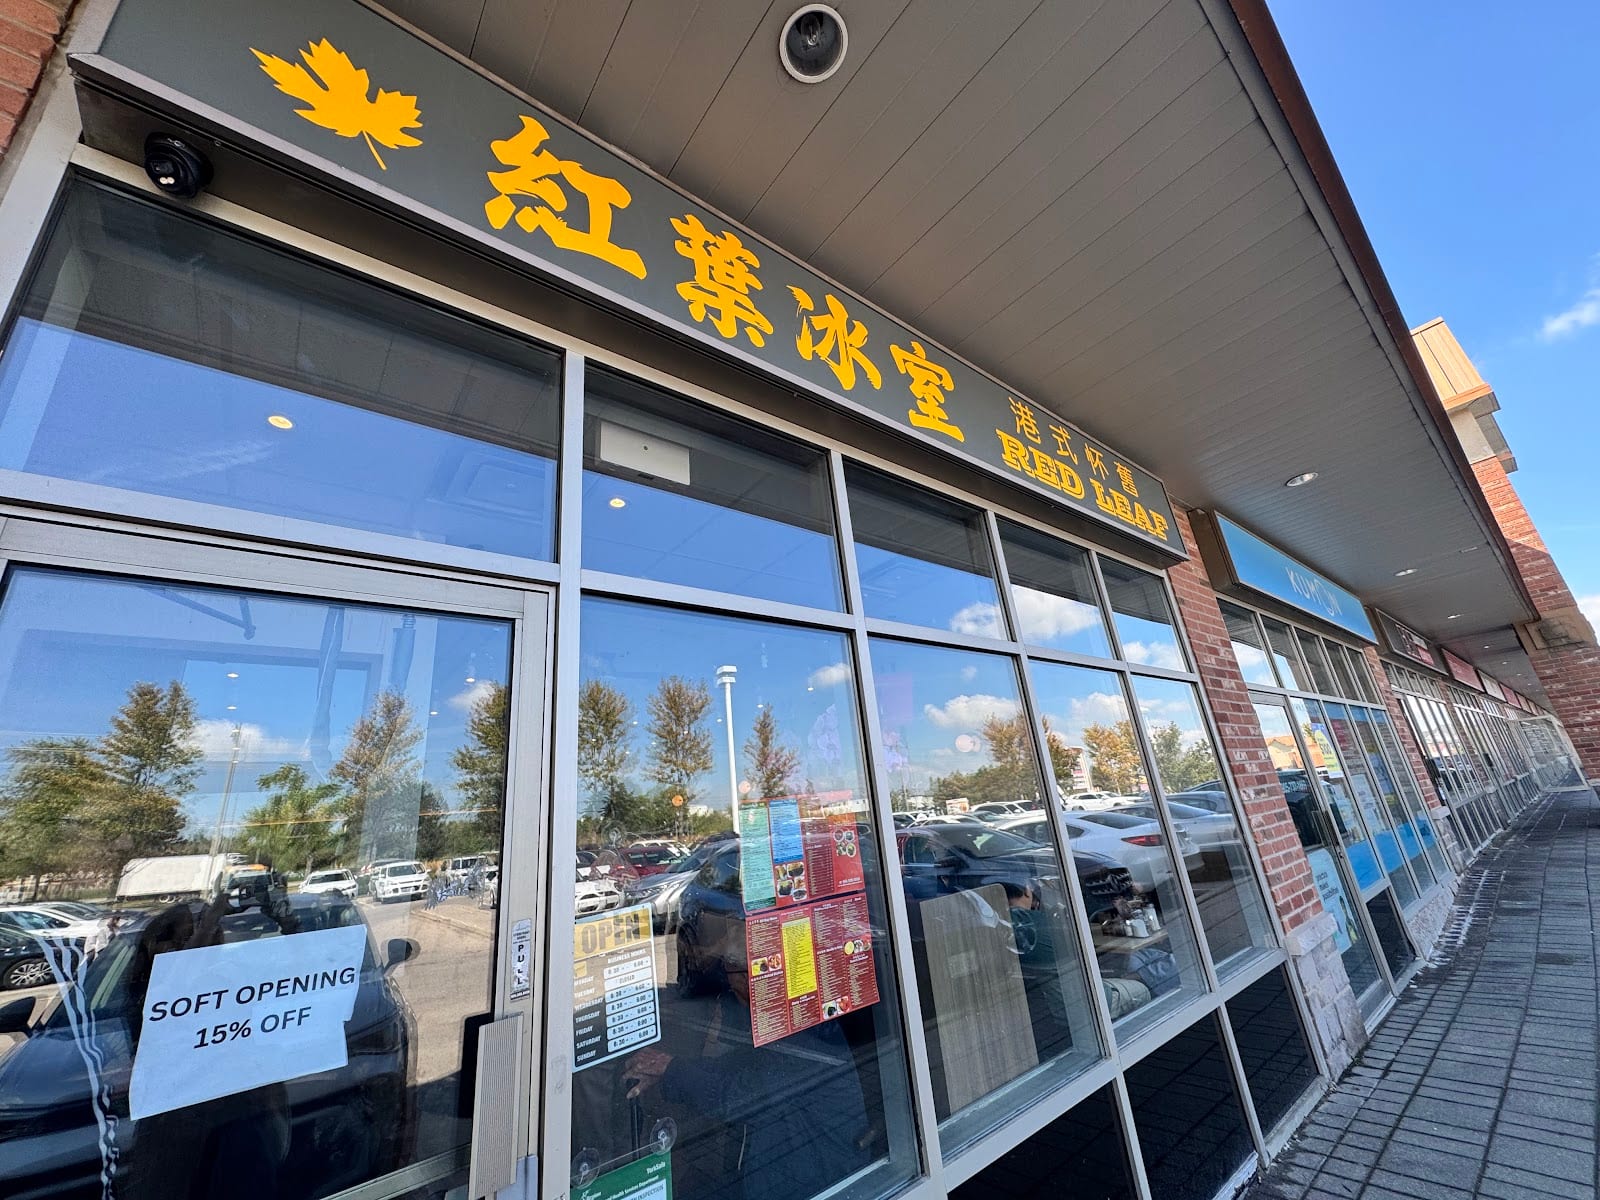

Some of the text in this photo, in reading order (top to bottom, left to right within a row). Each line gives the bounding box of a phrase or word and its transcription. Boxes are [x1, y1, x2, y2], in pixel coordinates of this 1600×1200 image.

[484, 114, 965, 443] 紅葉冰室
[995, 428, 1169, 541] RED LEAF
[1285, 566, 1342, 617] KUMON
[581, 912, 641, 954] OPEN
[517, 944, 525, 985] PULL
[149, 967, 355, 1022] SOFT OPENING
[193, 1006, 312, 1049] 15% OFF
[575, 1011, 601, 1024] THURSDAY
[576, 1025, 594, 1036] FRIDAY
[576, 1035, 601, 1049] SATURDAY
[577, 1050, 596, 1062] SUNDAY
